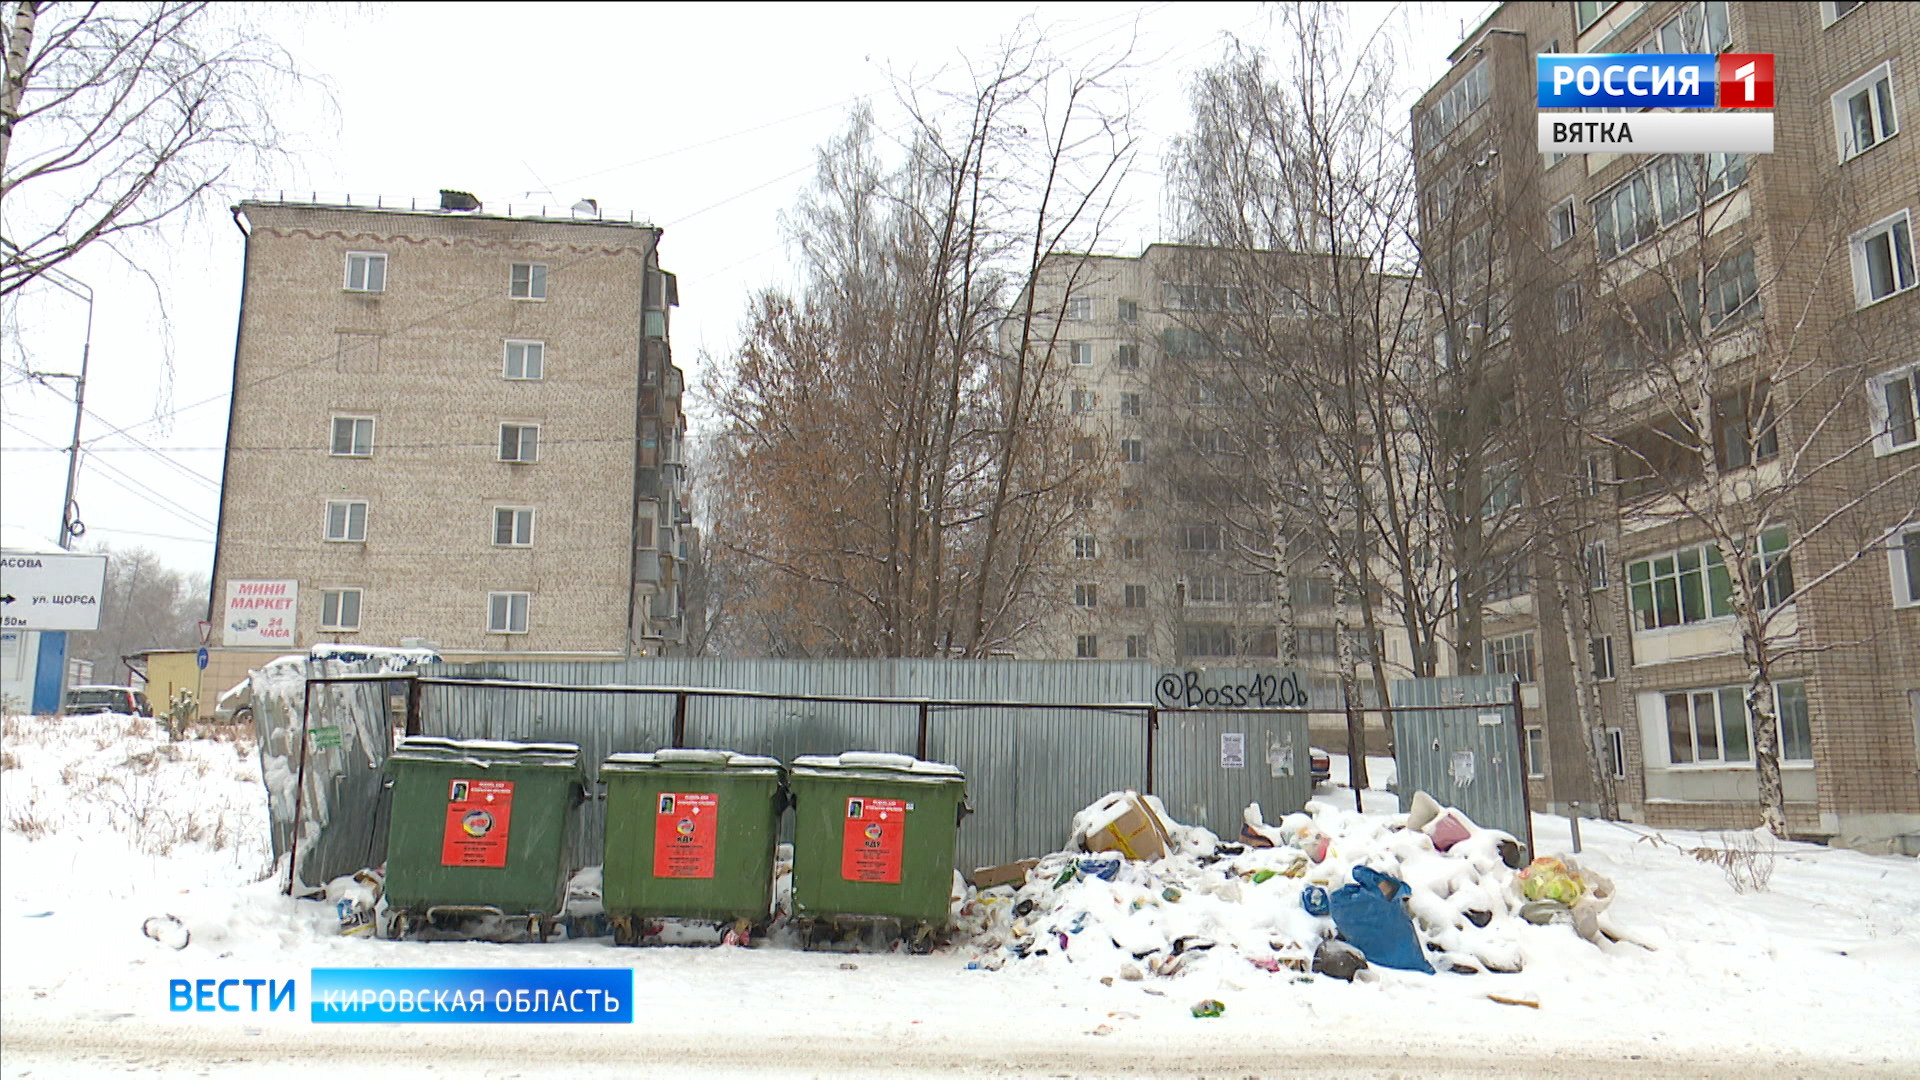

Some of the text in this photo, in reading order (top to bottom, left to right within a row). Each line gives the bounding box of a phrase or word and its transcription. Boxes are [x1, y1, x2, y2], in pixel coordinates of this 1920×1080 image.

[238, 583, 287, 596] МИНИ
[32, 594, 97, 606] ул. ЩОРСА
[230, 597, 294, 610] МАРКЕТ
[268, 617, 284, 628] 24
[260, 628, 291, 638] ЧАСА
[1155, 671, 1309, 708] @Boss420b
